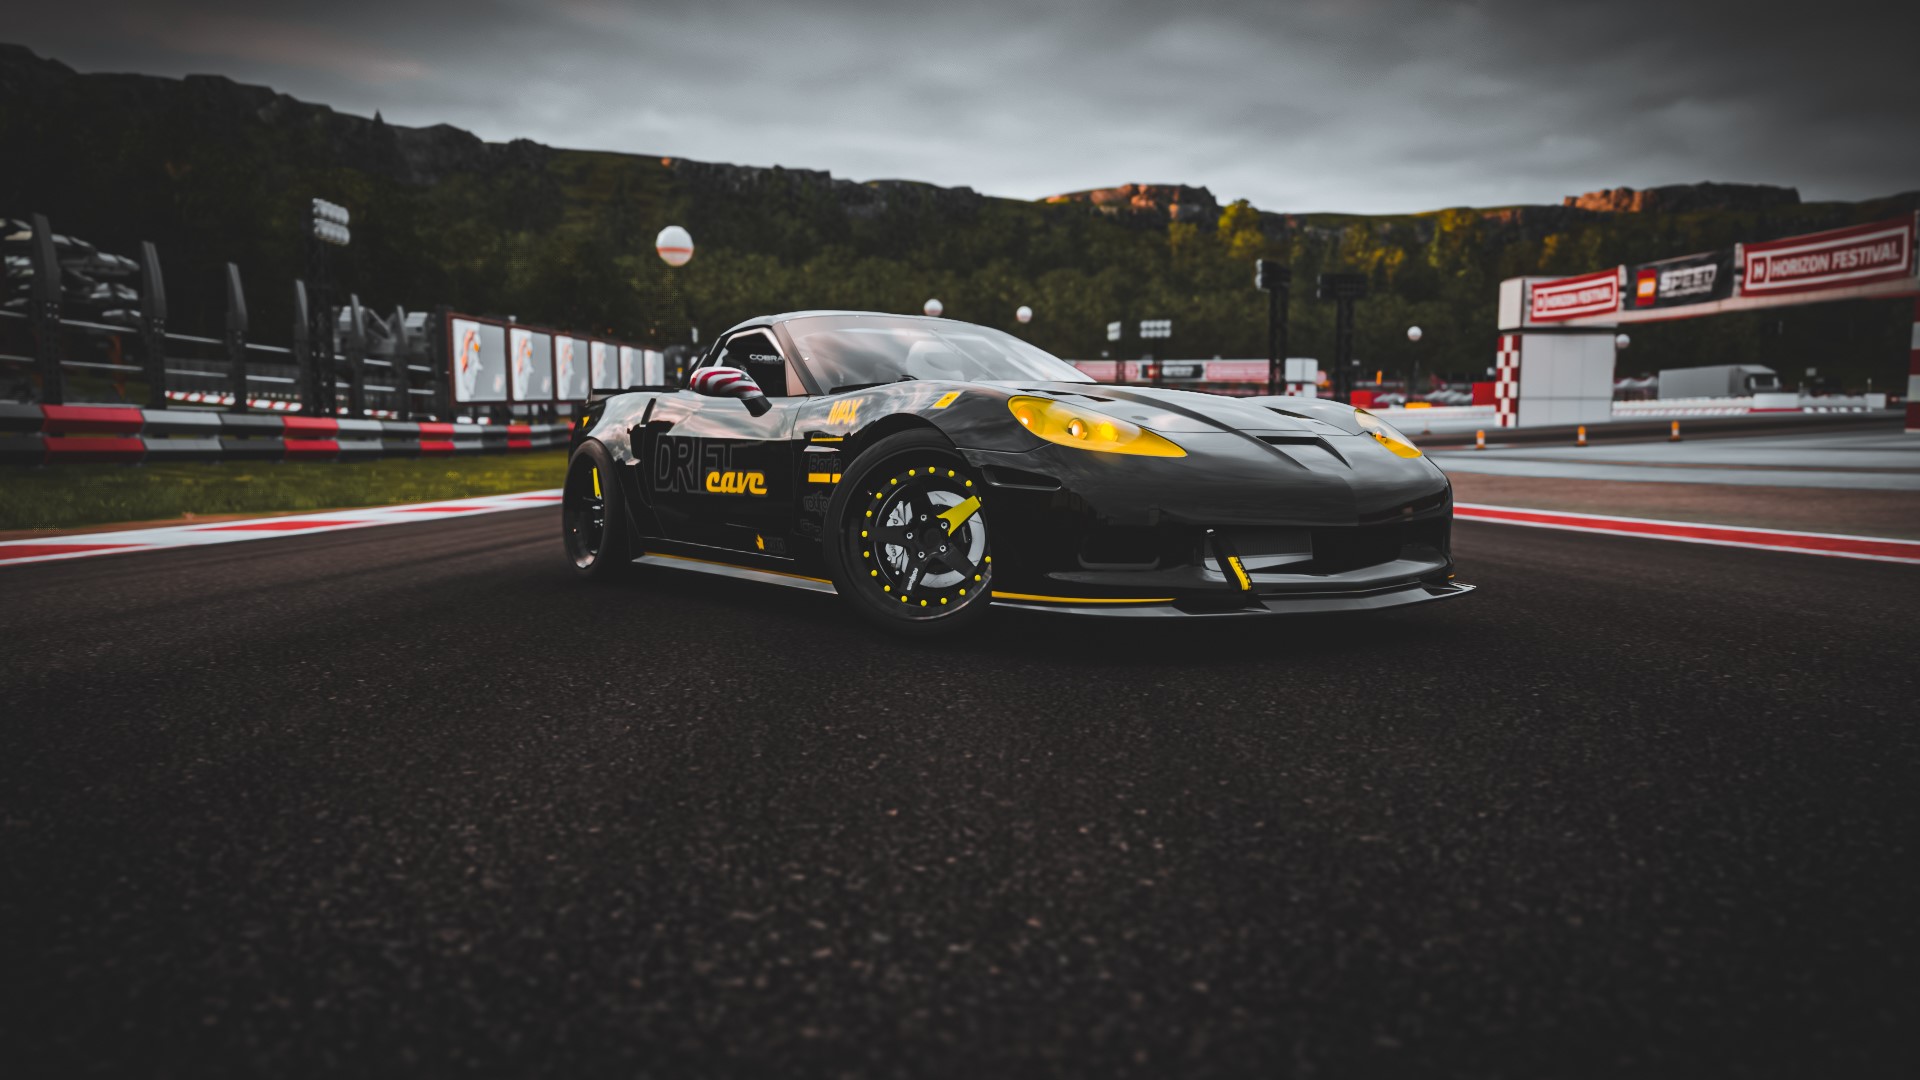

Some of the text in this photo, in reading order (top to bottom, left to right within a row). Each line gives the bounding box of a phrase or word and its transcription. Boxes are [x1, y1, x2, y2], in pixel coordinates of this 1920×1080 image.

[1770, 253, 1829, 277] HORIZON
[1832, 241, 1899, 269] FESTIVAL
[1660, 263, 1717, 291] SPEED
[749, 353, 783, 362] COBRA
[827, 398, 864, 425] MAX
